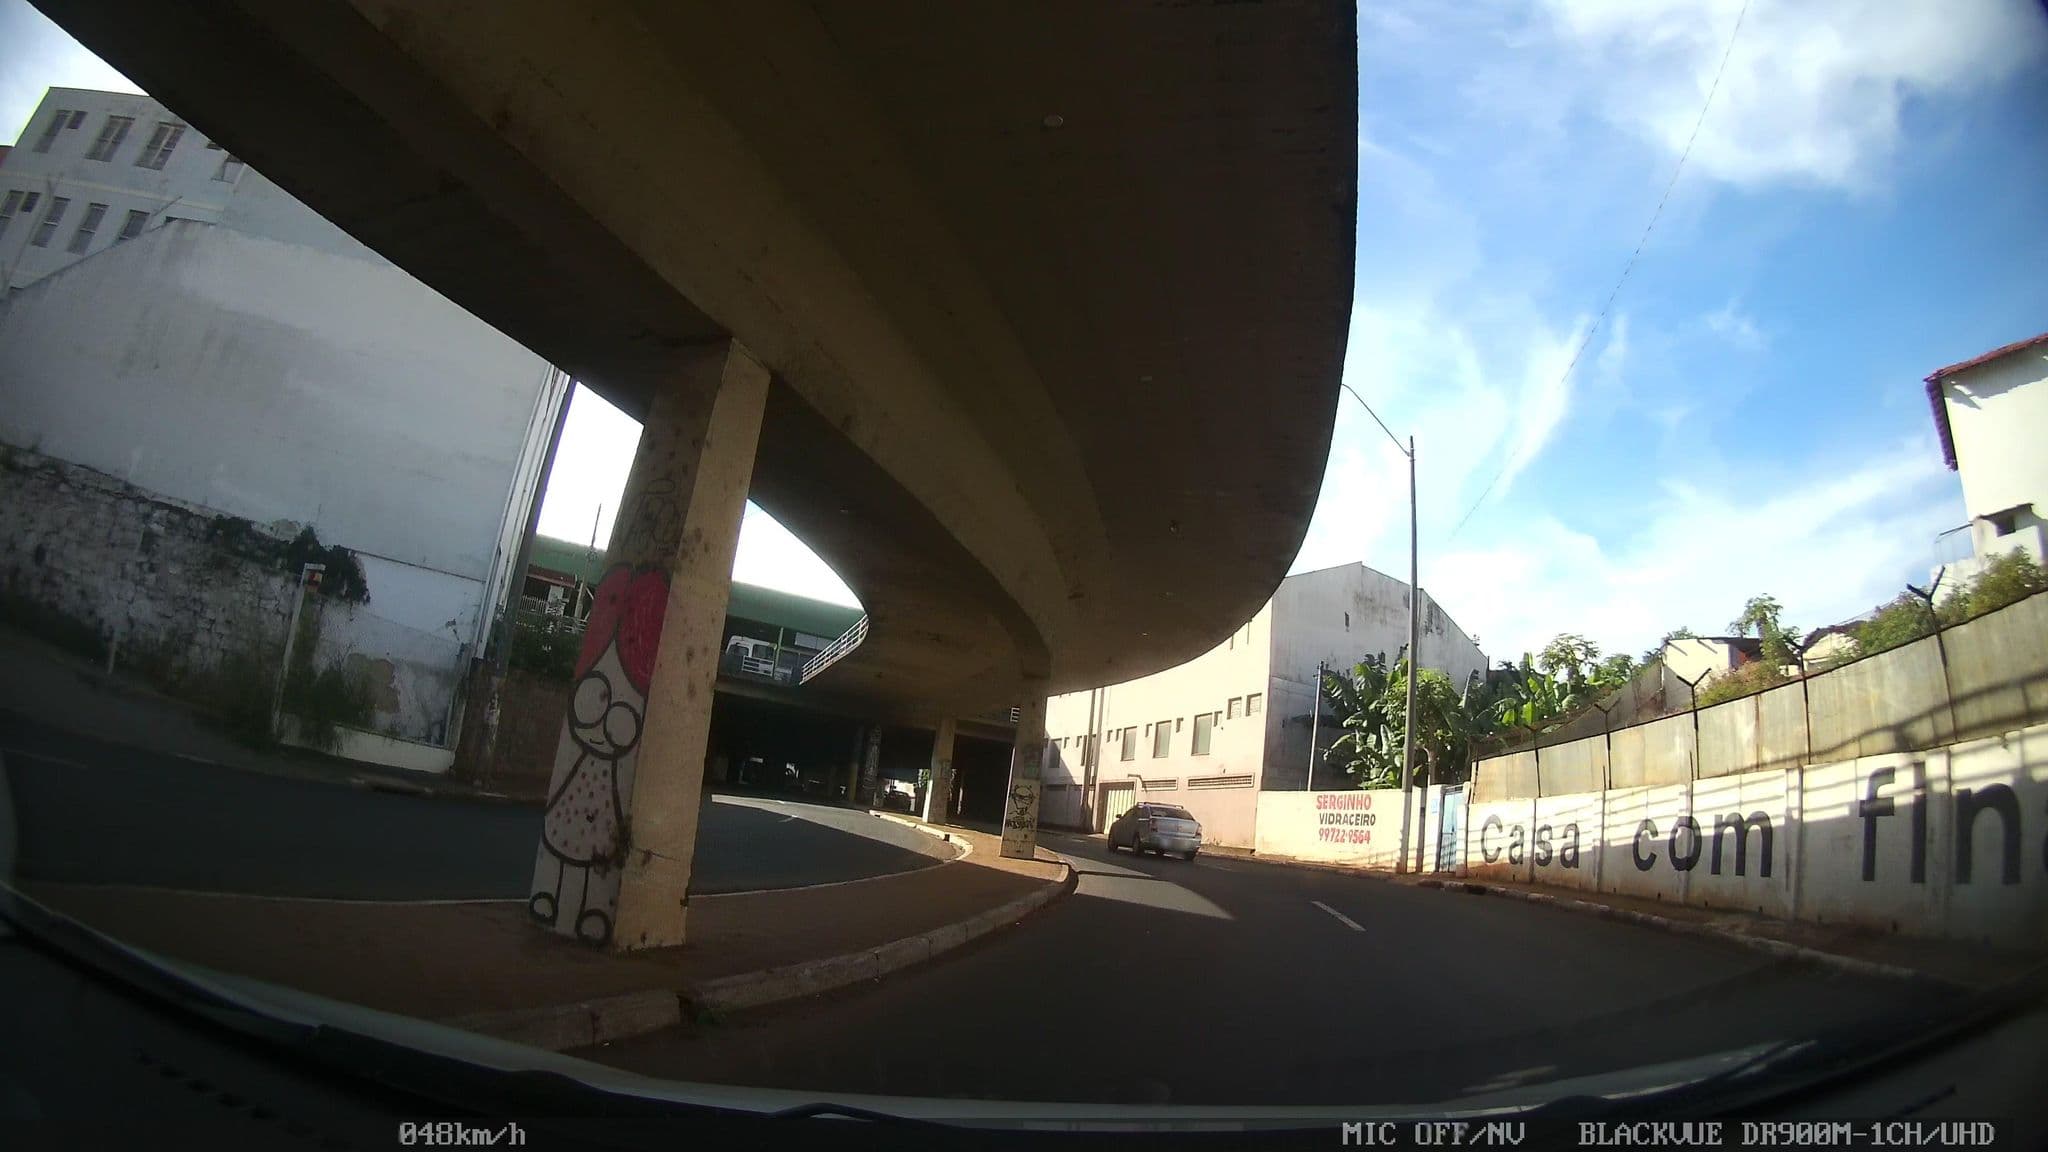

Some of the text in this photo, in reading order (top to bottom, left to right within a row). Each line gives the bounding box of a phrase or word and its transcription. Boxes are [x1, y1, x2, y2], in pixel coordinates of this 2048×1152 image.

[1316, 794, 1372, 810] SERGINHO
[1319, 812, 1376, 826] VIDRACEIRO
[1480, 761, 2048, 884] Casa com fin
